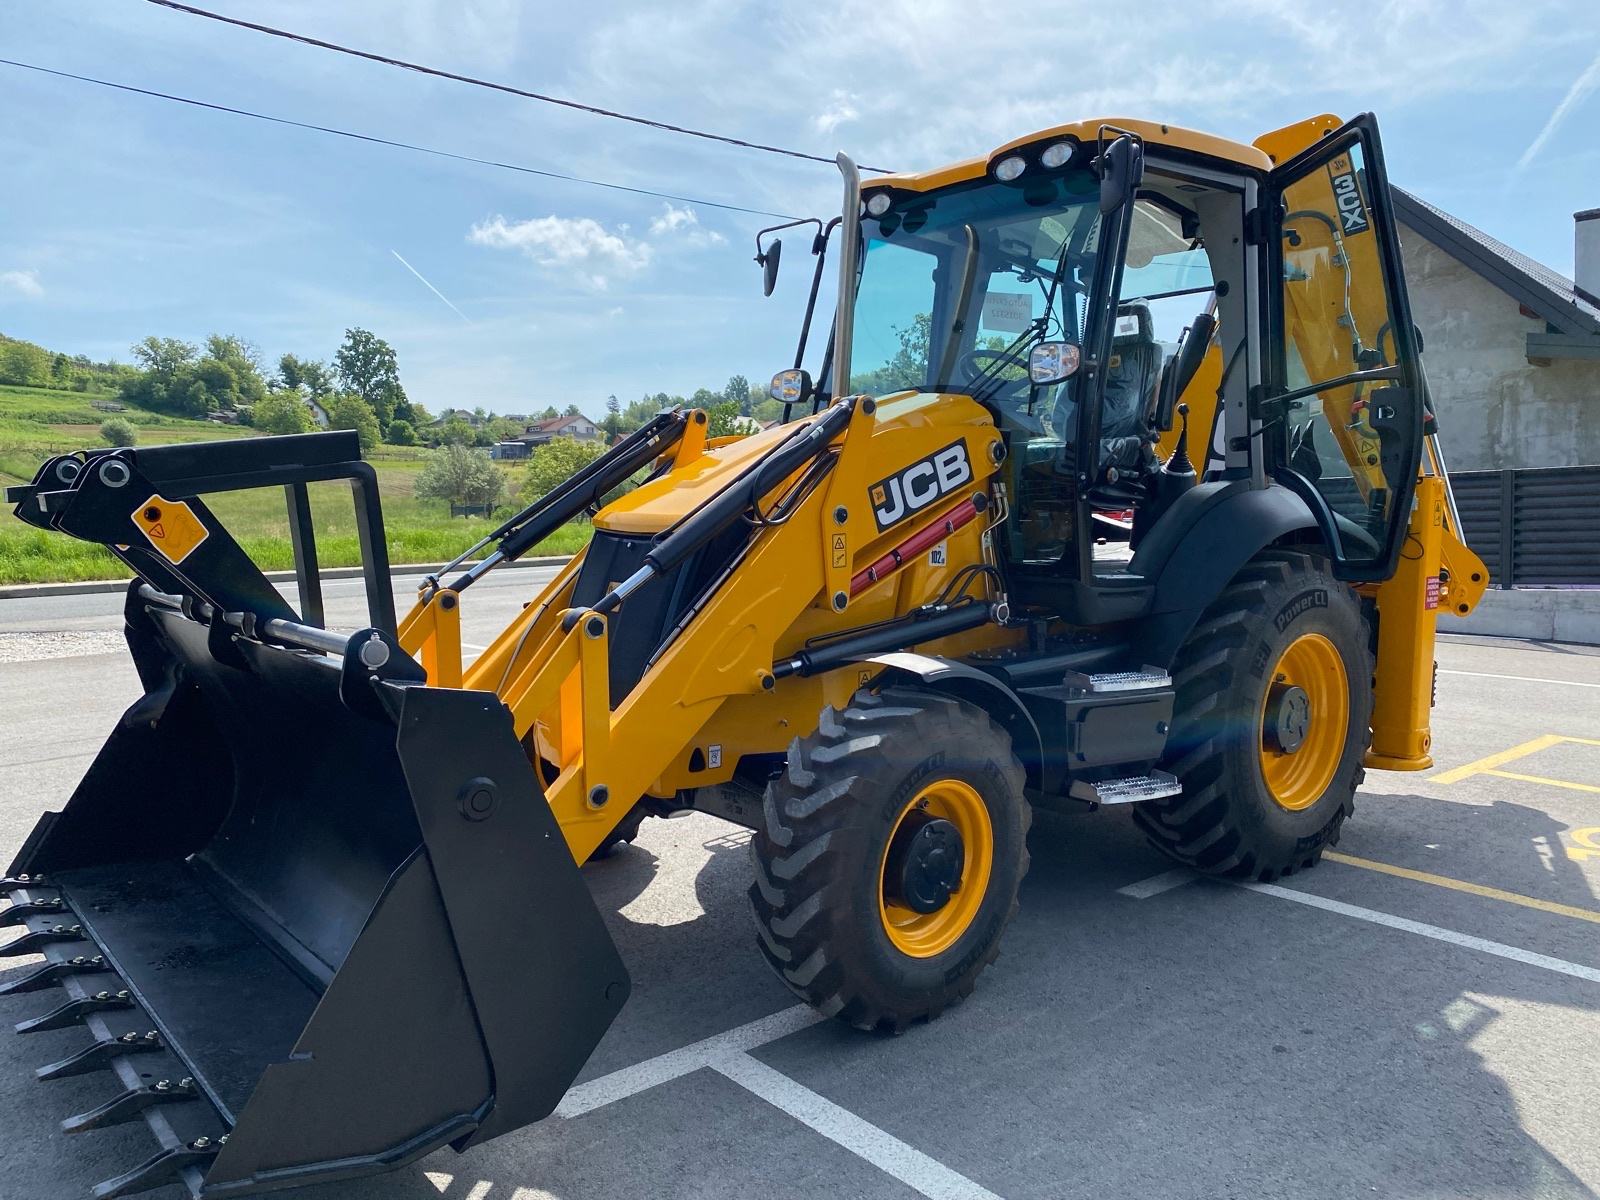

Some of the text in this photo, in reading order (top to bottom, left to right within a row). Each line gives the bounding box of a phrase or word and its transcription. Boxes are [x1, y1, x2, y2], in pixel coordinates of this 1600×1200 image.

[1334, 174, 1367, 229] 3CX
[877, 444, 971, 526] JCB
[931, 550, 941, 564] 102
[1276, 591, 1327, 632] Power CL
